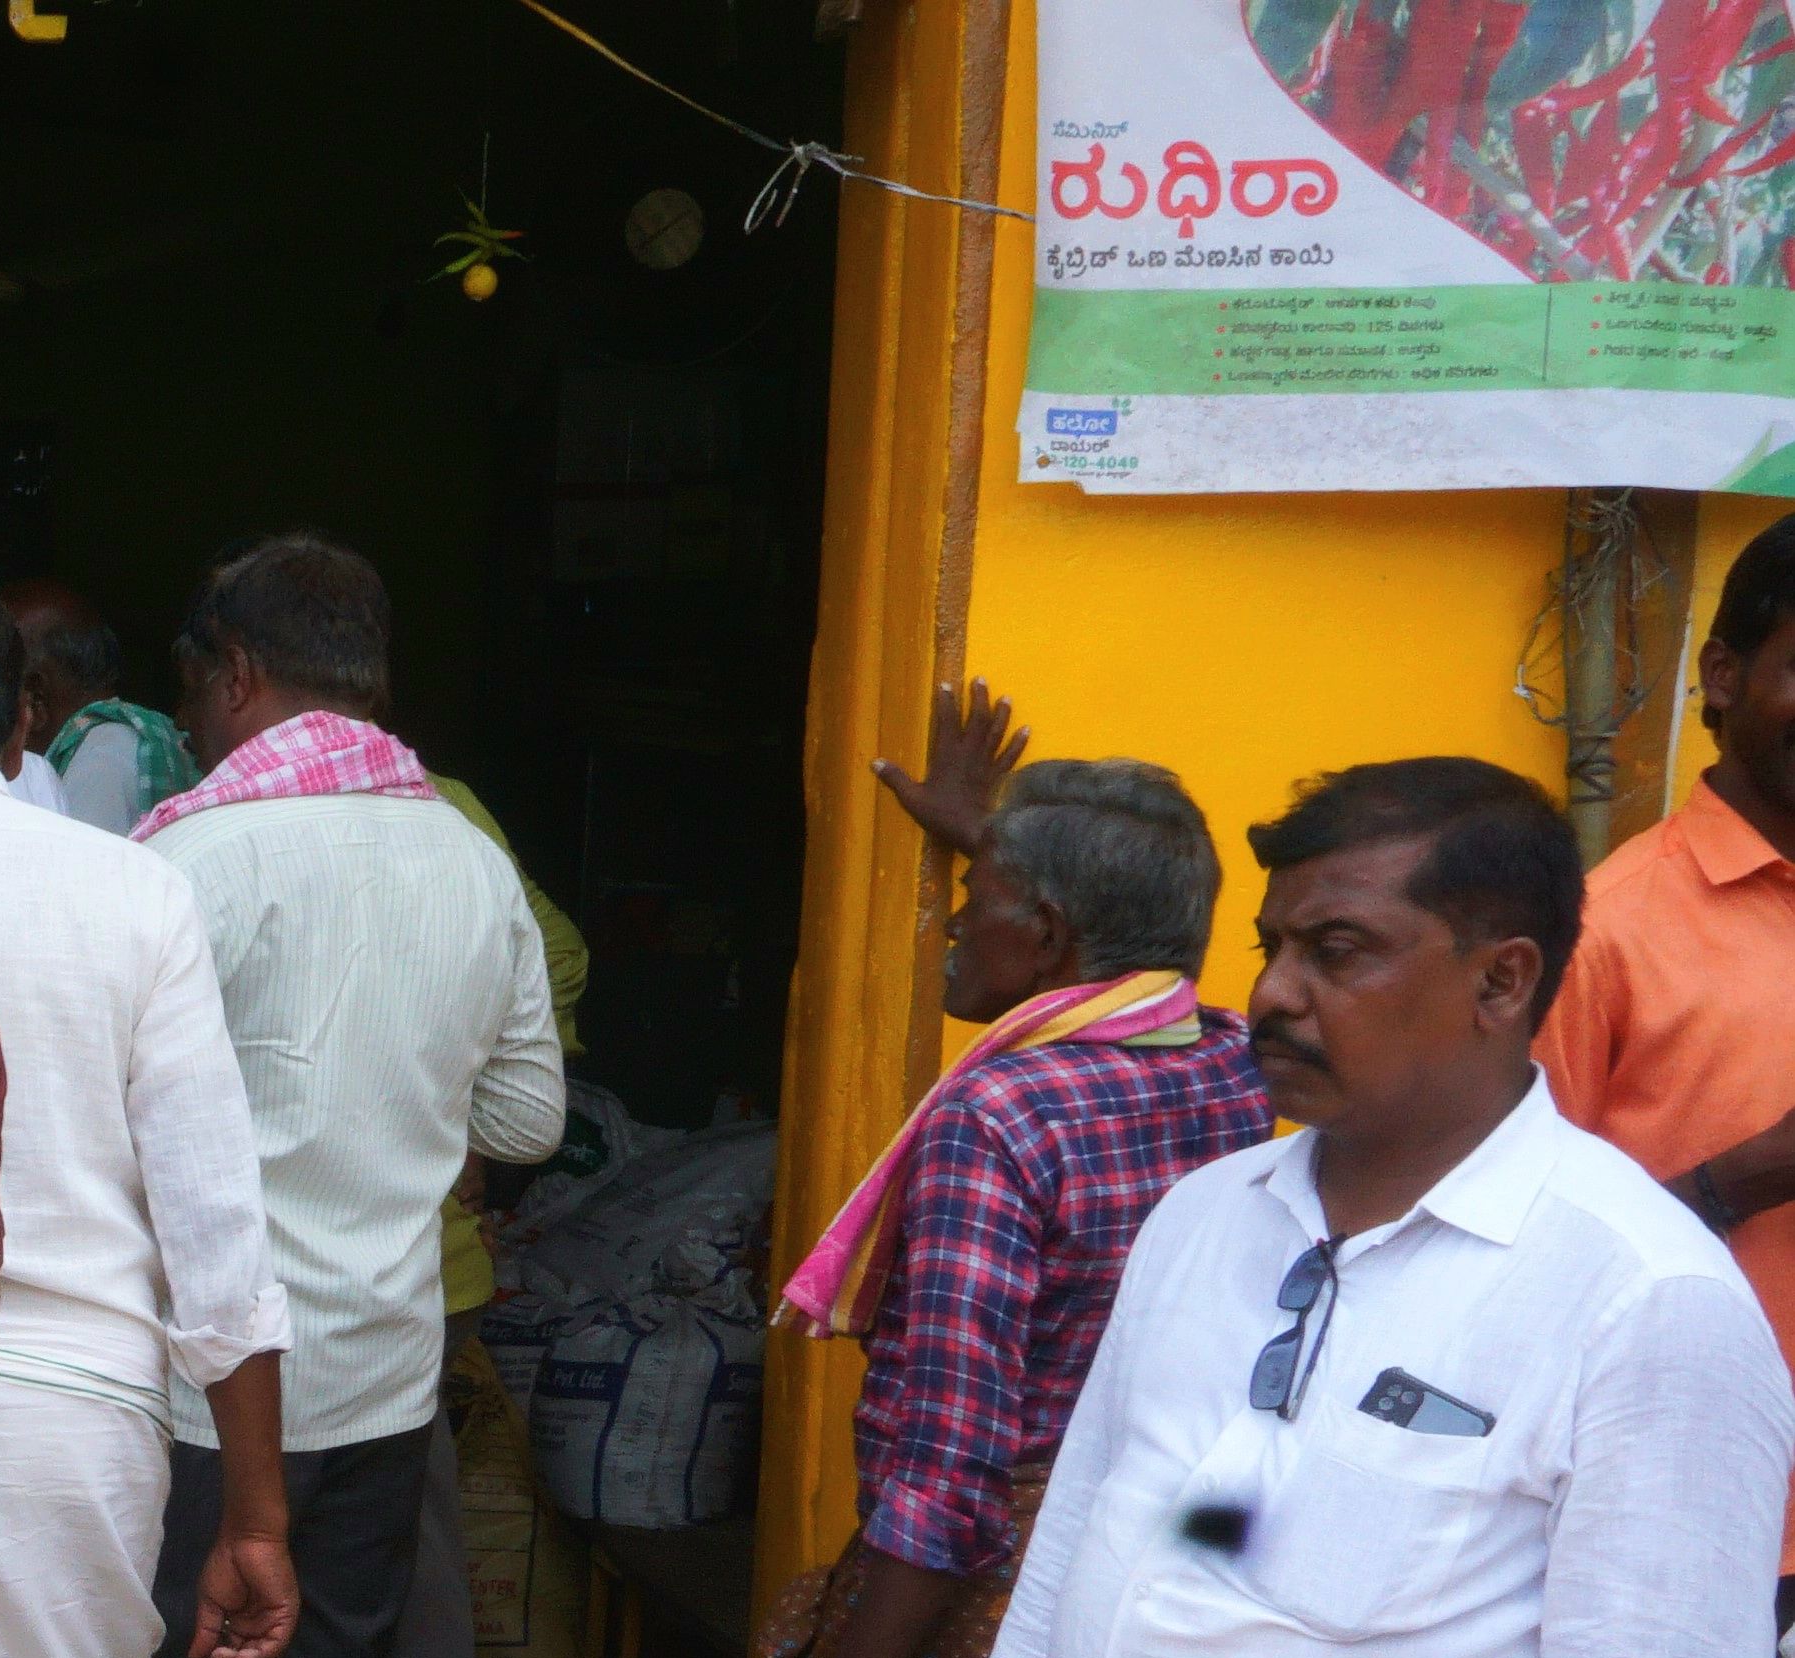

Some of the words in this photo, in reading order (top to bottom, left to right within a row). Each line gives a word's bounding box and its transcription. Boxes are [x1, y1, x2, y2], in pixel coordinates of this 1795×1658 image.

[1050, 140, 1339, 240] ರುಧಿರಾ
[1047, 244, 1119, 280] ಹೈಬ್ರಿಡ್
[1127, 247, 1167, 268] ಒಣ
[1174, 244, 1262, 269] ಮೆಣಸಿನ
[1270, 242, 1335, 266] ಕಾಯಿ
